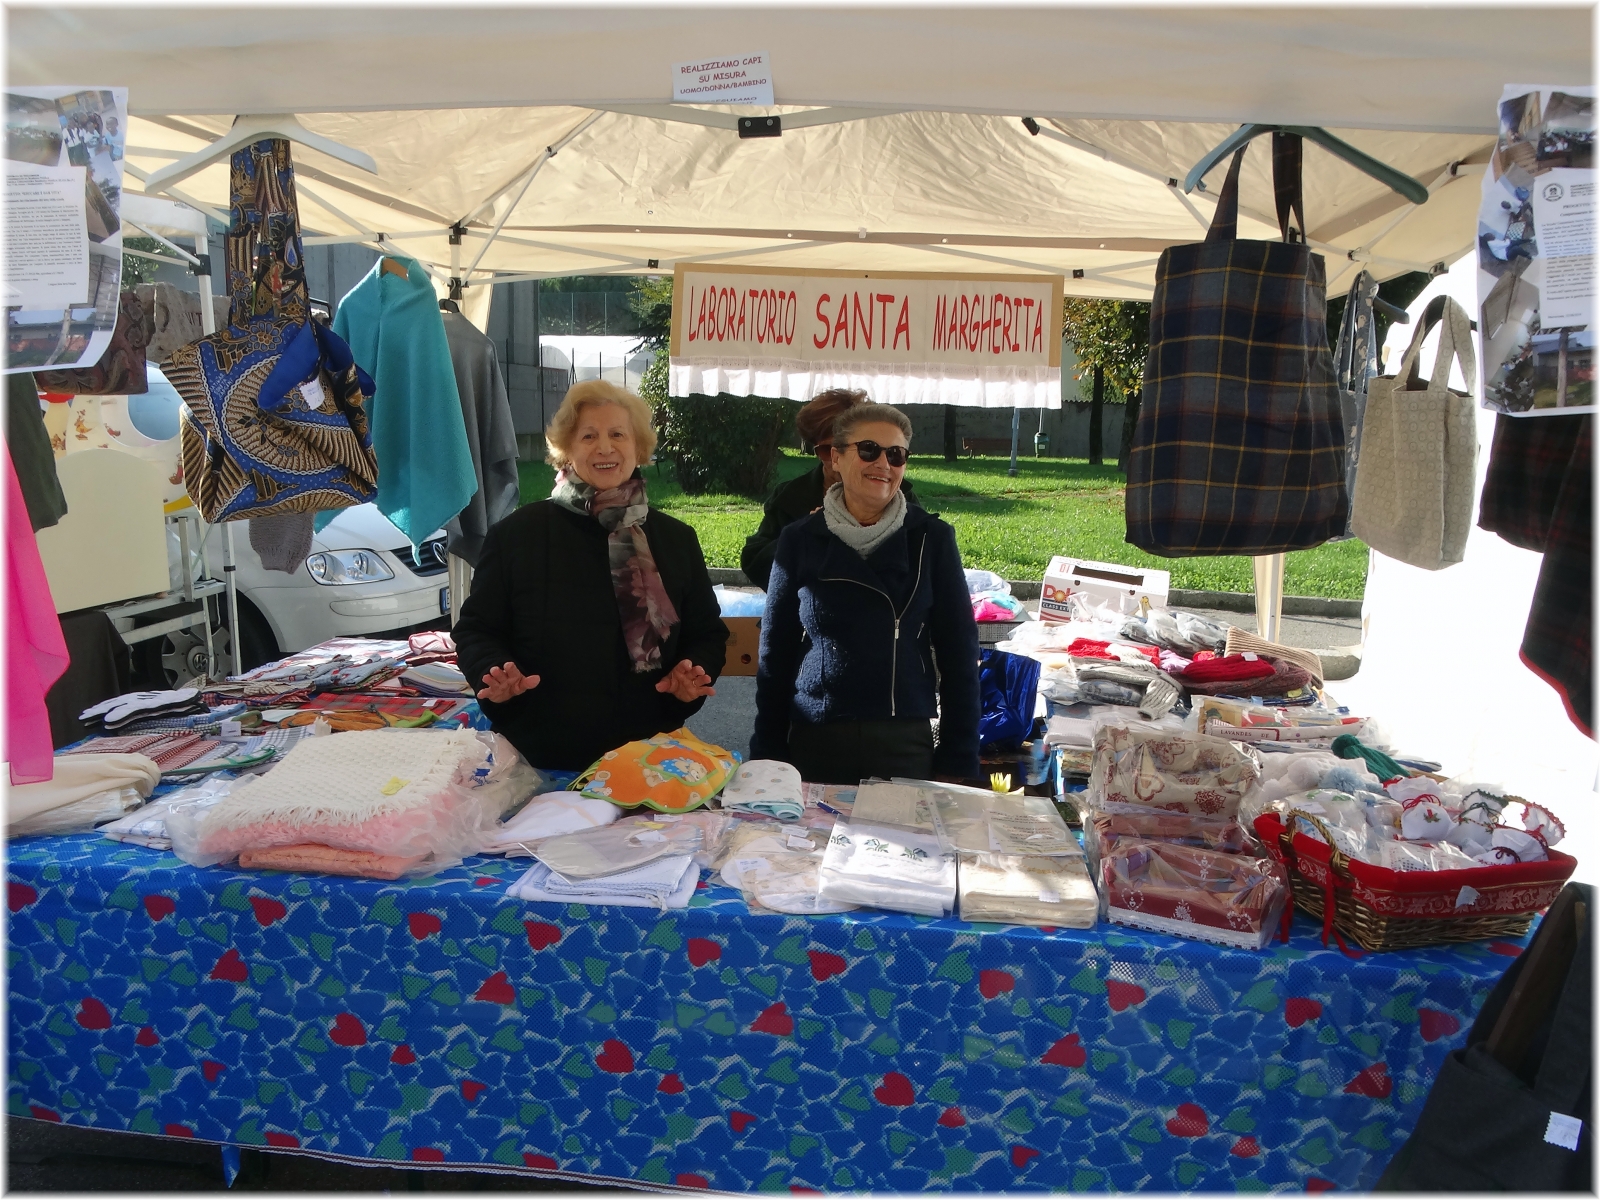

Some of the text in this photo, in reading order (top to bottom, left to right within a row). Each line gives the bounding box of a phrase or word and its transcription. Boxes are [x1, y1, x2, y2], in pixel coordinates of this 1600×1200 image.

[680, 56, 762, 74] REALIZZIAMO CAPI
[698, 70, 747, 83] SU MISURA
[680, 78, 767, 94] UOMO/DONNA/BAMBINO
[688, 285, 1044, 354] LABORATORIO SANTA MARGHERITA
[1042, 602, 1059, 610] CLASS
[1220, 729, 1252, 737] LAVANDES
